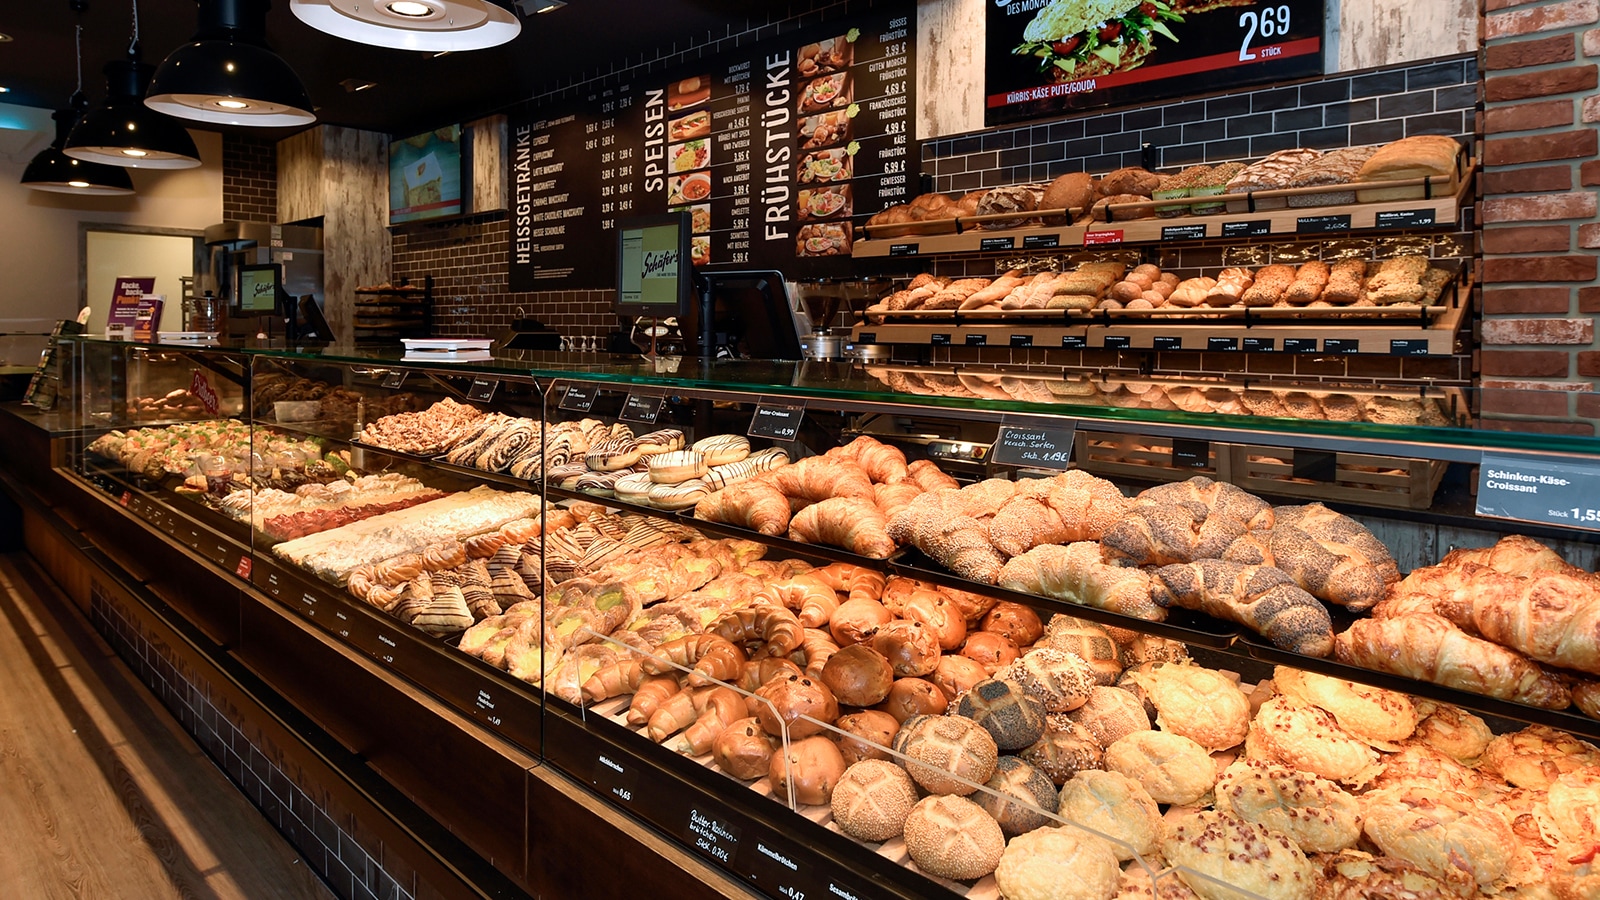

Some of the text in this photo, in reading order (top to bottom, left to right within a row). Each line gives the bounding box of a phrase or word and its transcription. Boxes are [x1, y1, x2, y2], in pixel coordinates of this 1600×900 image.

[1007, 2, 1020, 16] DES
[889, 17, 907, 30] SÜSSES
[880, 29, 907, 43] FRÜHSTÜCK
[886, 44, 899, 58] 3,99
[1261, 47, 1282, 57] STÜCK
[729, 61, 750, 74] BOCKWURST
[869, 56, 907, 73] GUTEN MORGEN
[731, 71, 750, 82] BRÖTCHEN
[879, 68, 907, 82] FRÜHSTÜCK
[735, 84, 744, 95] 1,79
[885, 83, 899, 96] 4,69
[1007, 79, 1096, 104] KÜRBIS-KÄSE PUTE/GOUDA
[737, 95, 750, 104] PANINI
[869, 96, 907, 111] FRANZÖSISCHES
[736, 105, 750, 114] SORTEN
[879, 107, 907, 120] FRÜHSTÜCK
[885, 122, 899, 135] 4,99
[645, 89, 664, 192] SPEISEN
[718, 133, 730, 142] RÜHREI
[739, 129, 750, 138] SPECK
[894, 135, 906, 145] KÄSE
[732, 139, 750, 149] ZWIEBELN
[761, 50, 790, 240] FRÜHSTÜCKE
[879, 146, 906, 158] FRÜHSTÜCK
[736, 163, 750, 172] SUPPEN
[884, 161, 898, 173] 6,99
[723, 173, 750, 184] NACH ANGEBOT
[880, 175, 906, 186] GENIESSER
[514, 124, 531, 264] HEISSGETRÄNKE
[878, 186, 906, 197] FRÜHSTÜCK
[735, 198, 750, 206] BAUERN
[731, 207, 750, 216] OMELETTE
[730, 231, 749, 240] SCHNITZEL
[735, 241, 749, 249] BEILAGE
[641, 249, 678, 280] Schäfer's
[760, 409, 790, 417] Butter-Croissant
[781, 428, 794, 436] 0,99
[1005, 430, 1046, 440] Croissant
[1029, 441, 1055, 449] Sorten
[1487, 470, 1570, 486] Schinken-Käse-
[1486, 480, 1538, 494] Croissant
[1548, 510, 1568, 518] Stück
[599, 755, 624, 773] Milchhörnchen
[619, 788, 630, 800] 0,65
[690, 821, 717, 843] brötchen
[757, 843, 798, 871] Kümmelbrötchen
[788, 887, 805, 900] 0,47
